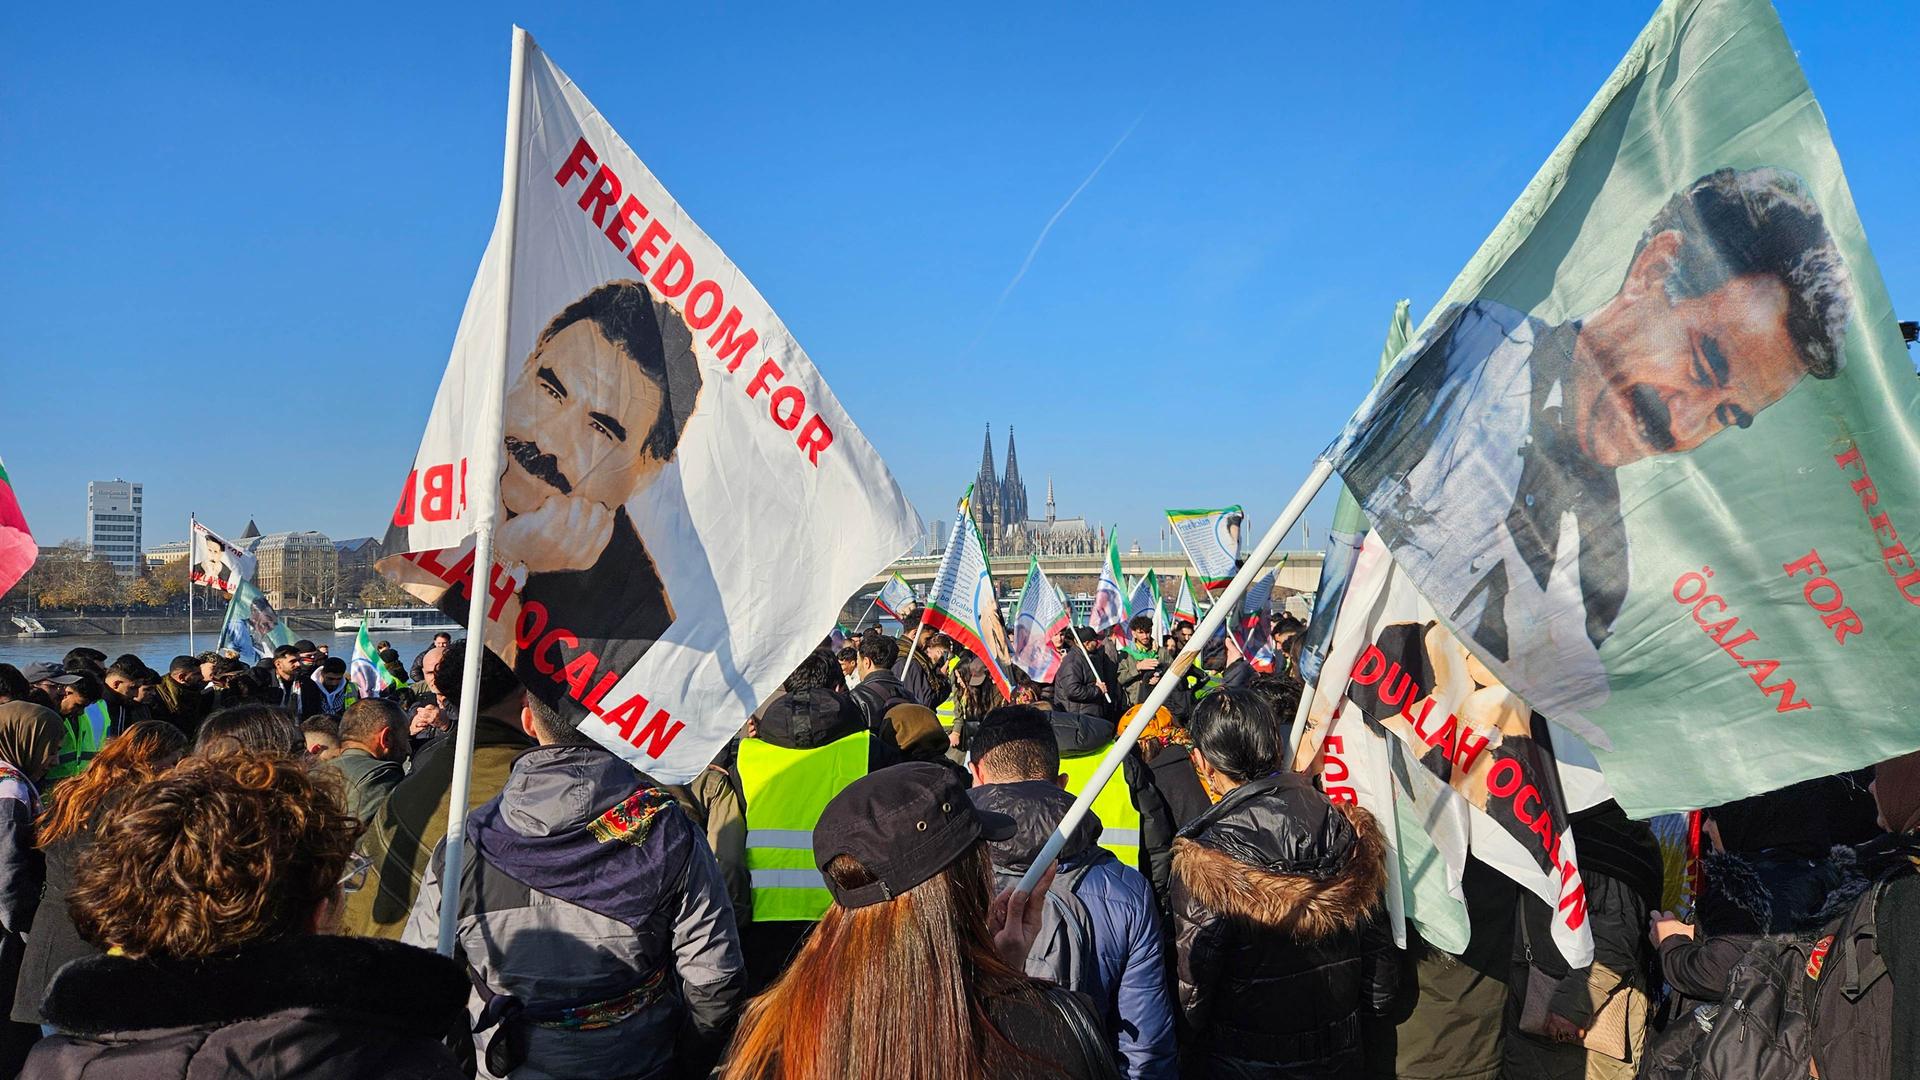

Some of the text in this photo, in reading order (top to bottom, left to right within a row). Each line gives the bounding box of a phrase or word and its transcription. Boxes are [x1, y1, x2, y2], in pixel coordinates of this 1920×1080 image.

[554, 136, 834, 468] FREEDOM FOR
[1672, 565, 1813, 713] ÖCALAN
[1783, 548, 1864, 646] FOR
[515, 601, 686, 760] OCALAN
[1350, 643, 1490, 775] DULLAH
